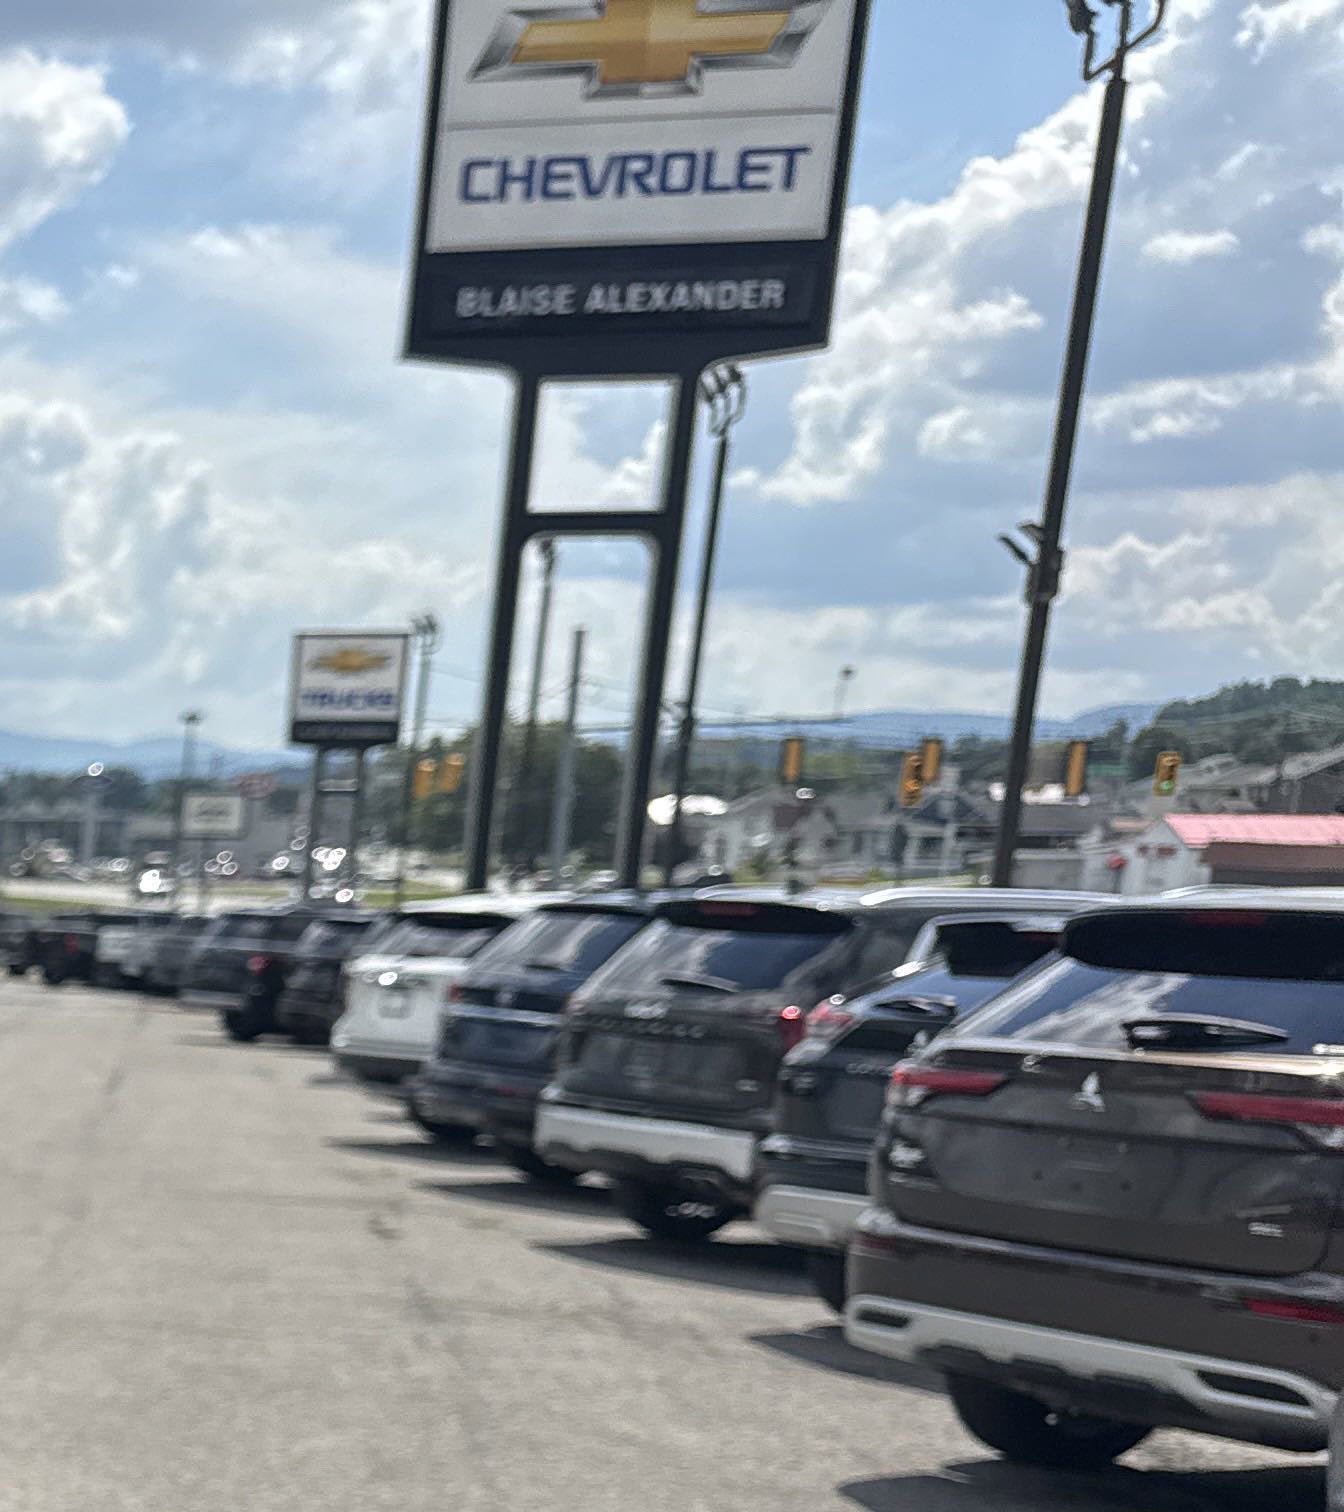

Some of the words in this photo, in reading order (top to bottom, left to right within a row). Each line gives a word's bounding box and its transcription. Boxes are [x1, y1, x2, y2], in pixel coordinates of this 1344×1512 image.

[458, 147, 812, 205] CHEVROLET
[455, 283, 576, 318] BLAISE
[583, 278, 786, 314] ALEXANDER
